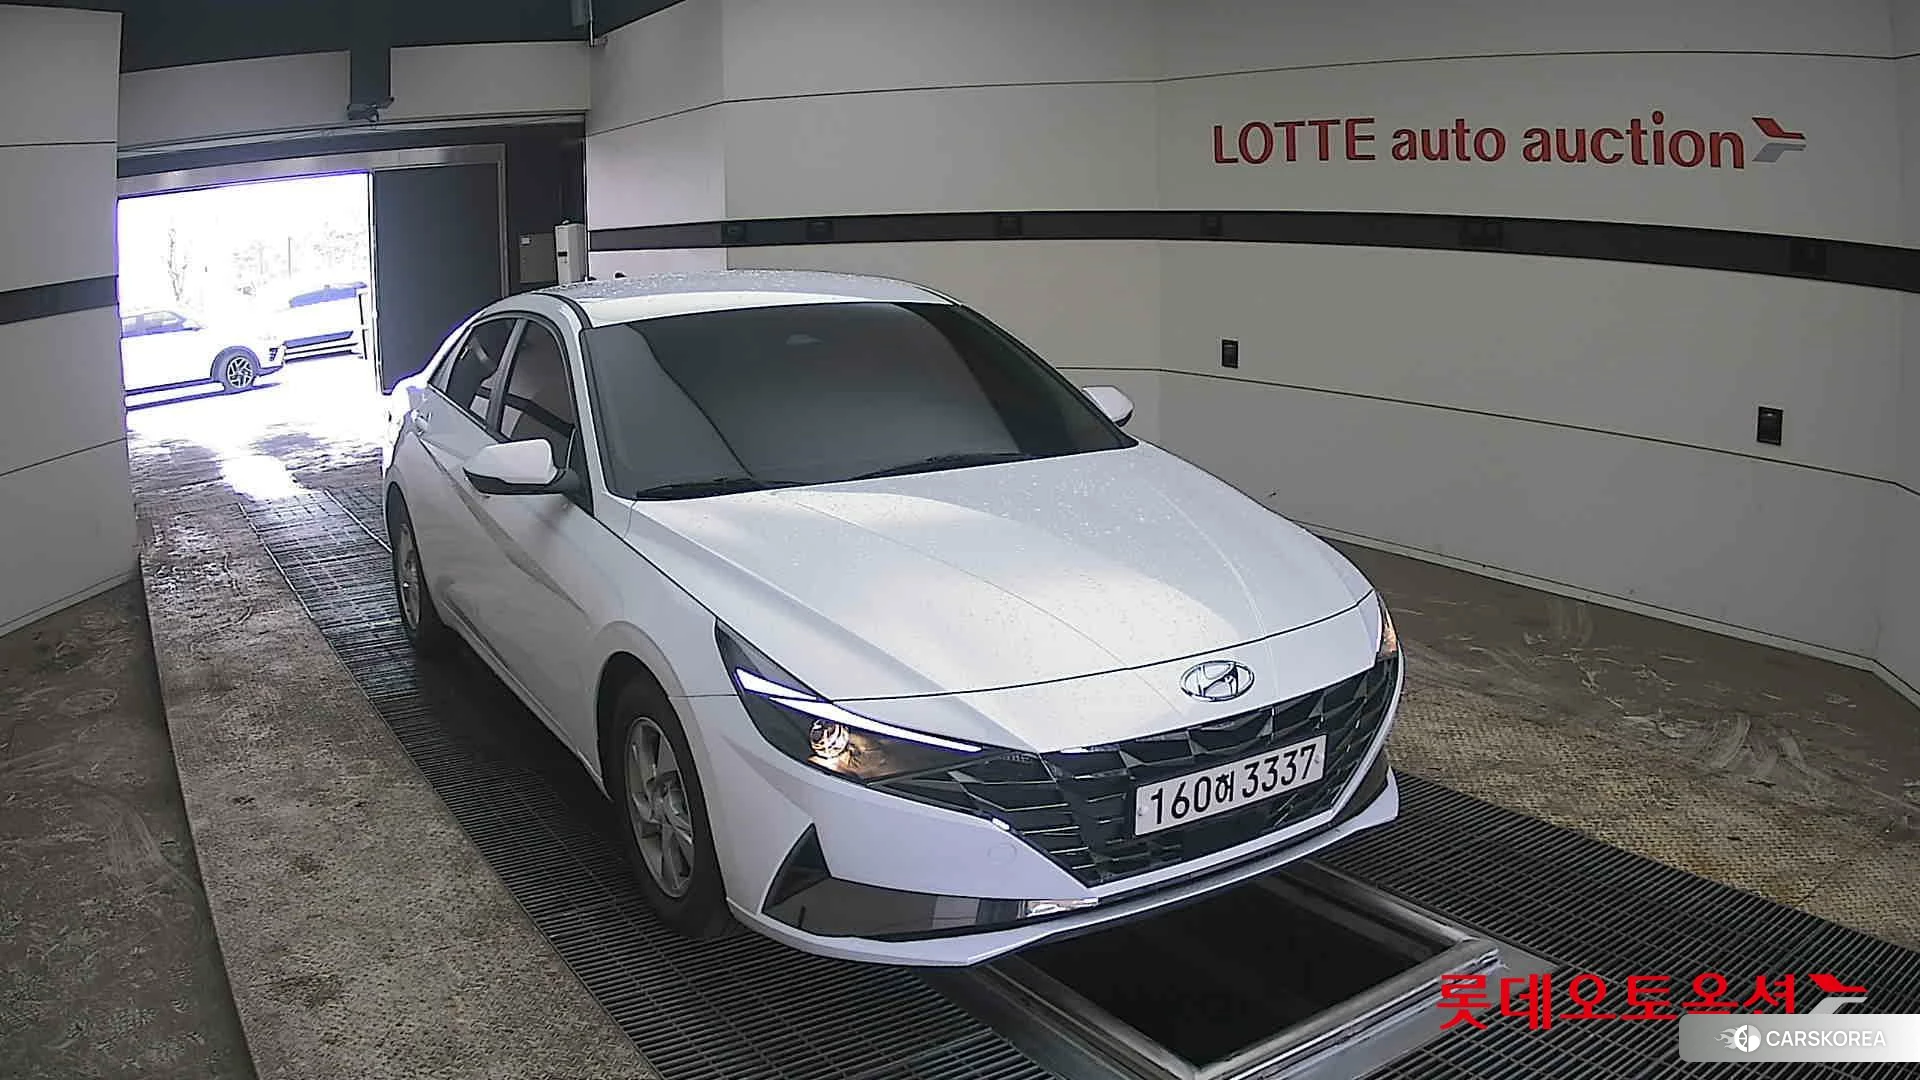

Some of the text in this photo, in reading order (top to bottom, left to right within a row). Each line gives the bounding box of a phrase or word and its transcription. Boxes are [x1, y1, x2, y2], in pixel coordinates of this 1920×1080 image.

[1213, 110, 1746, 169] LOTTE auto auction
[1151, 743, 1317, 825] 160허 3337
